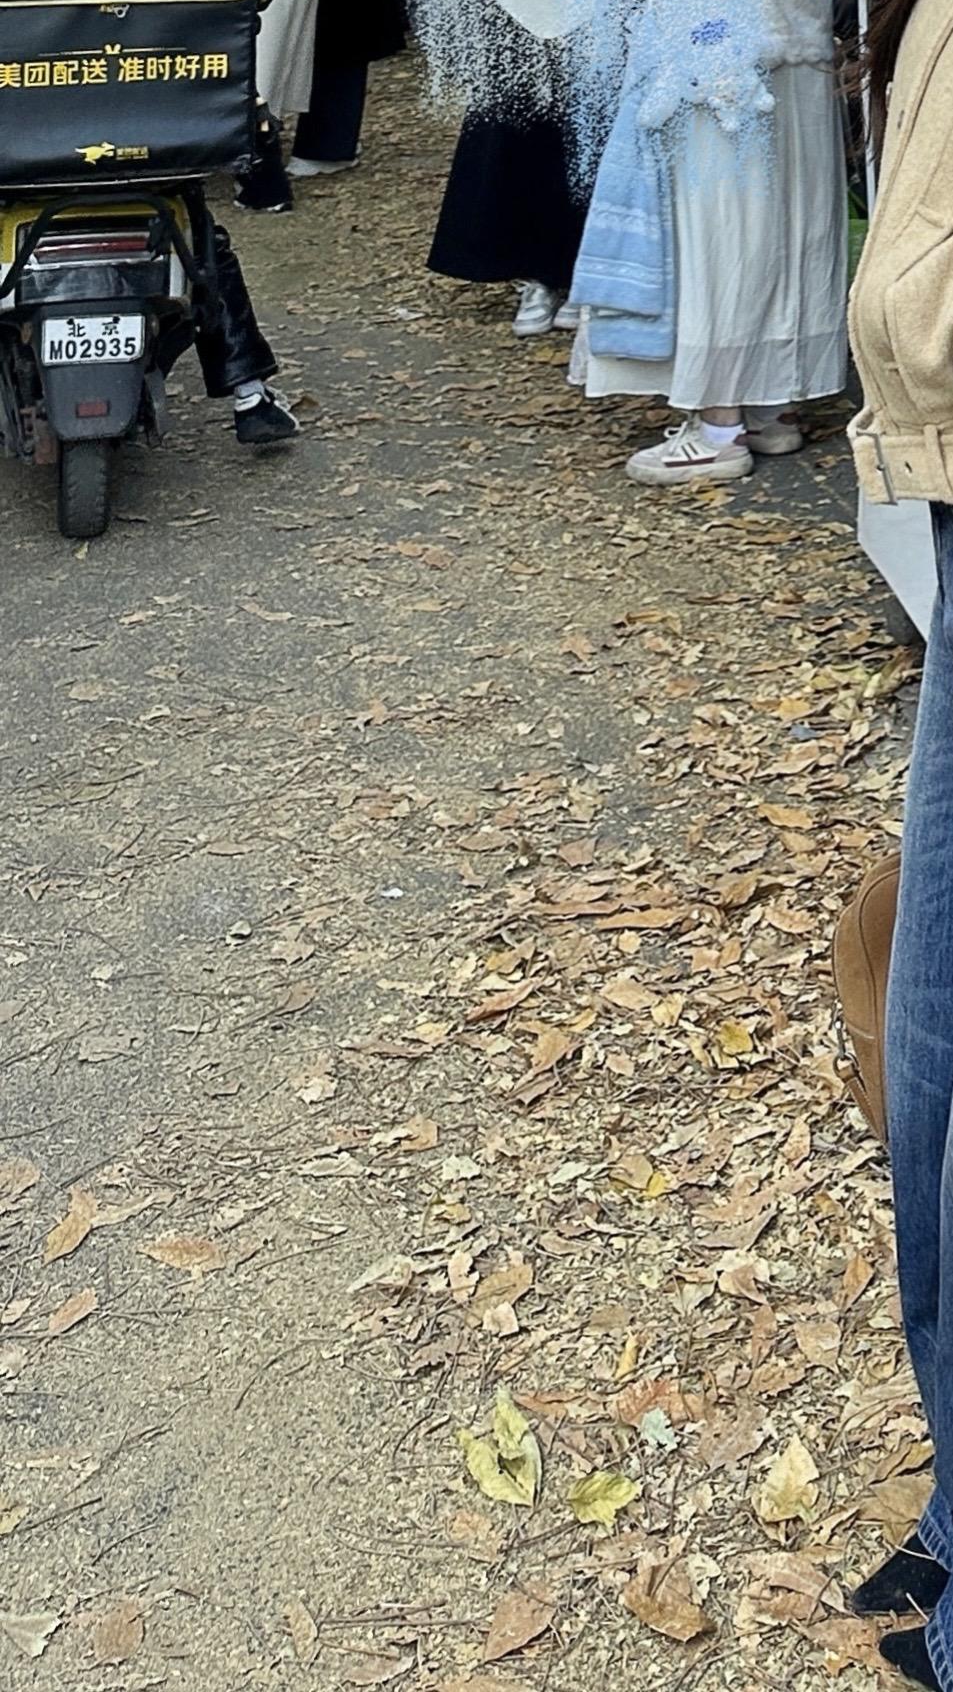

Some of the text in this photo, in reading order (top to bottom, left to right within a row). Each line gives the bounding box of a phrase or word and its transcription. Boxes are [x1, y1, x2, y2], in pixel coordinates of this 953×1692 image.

[0, 53, 229, 88] 美团配送 准时好用
[67, 320, 120, 338] 北京
[49, 337, 136, 361] M02935
